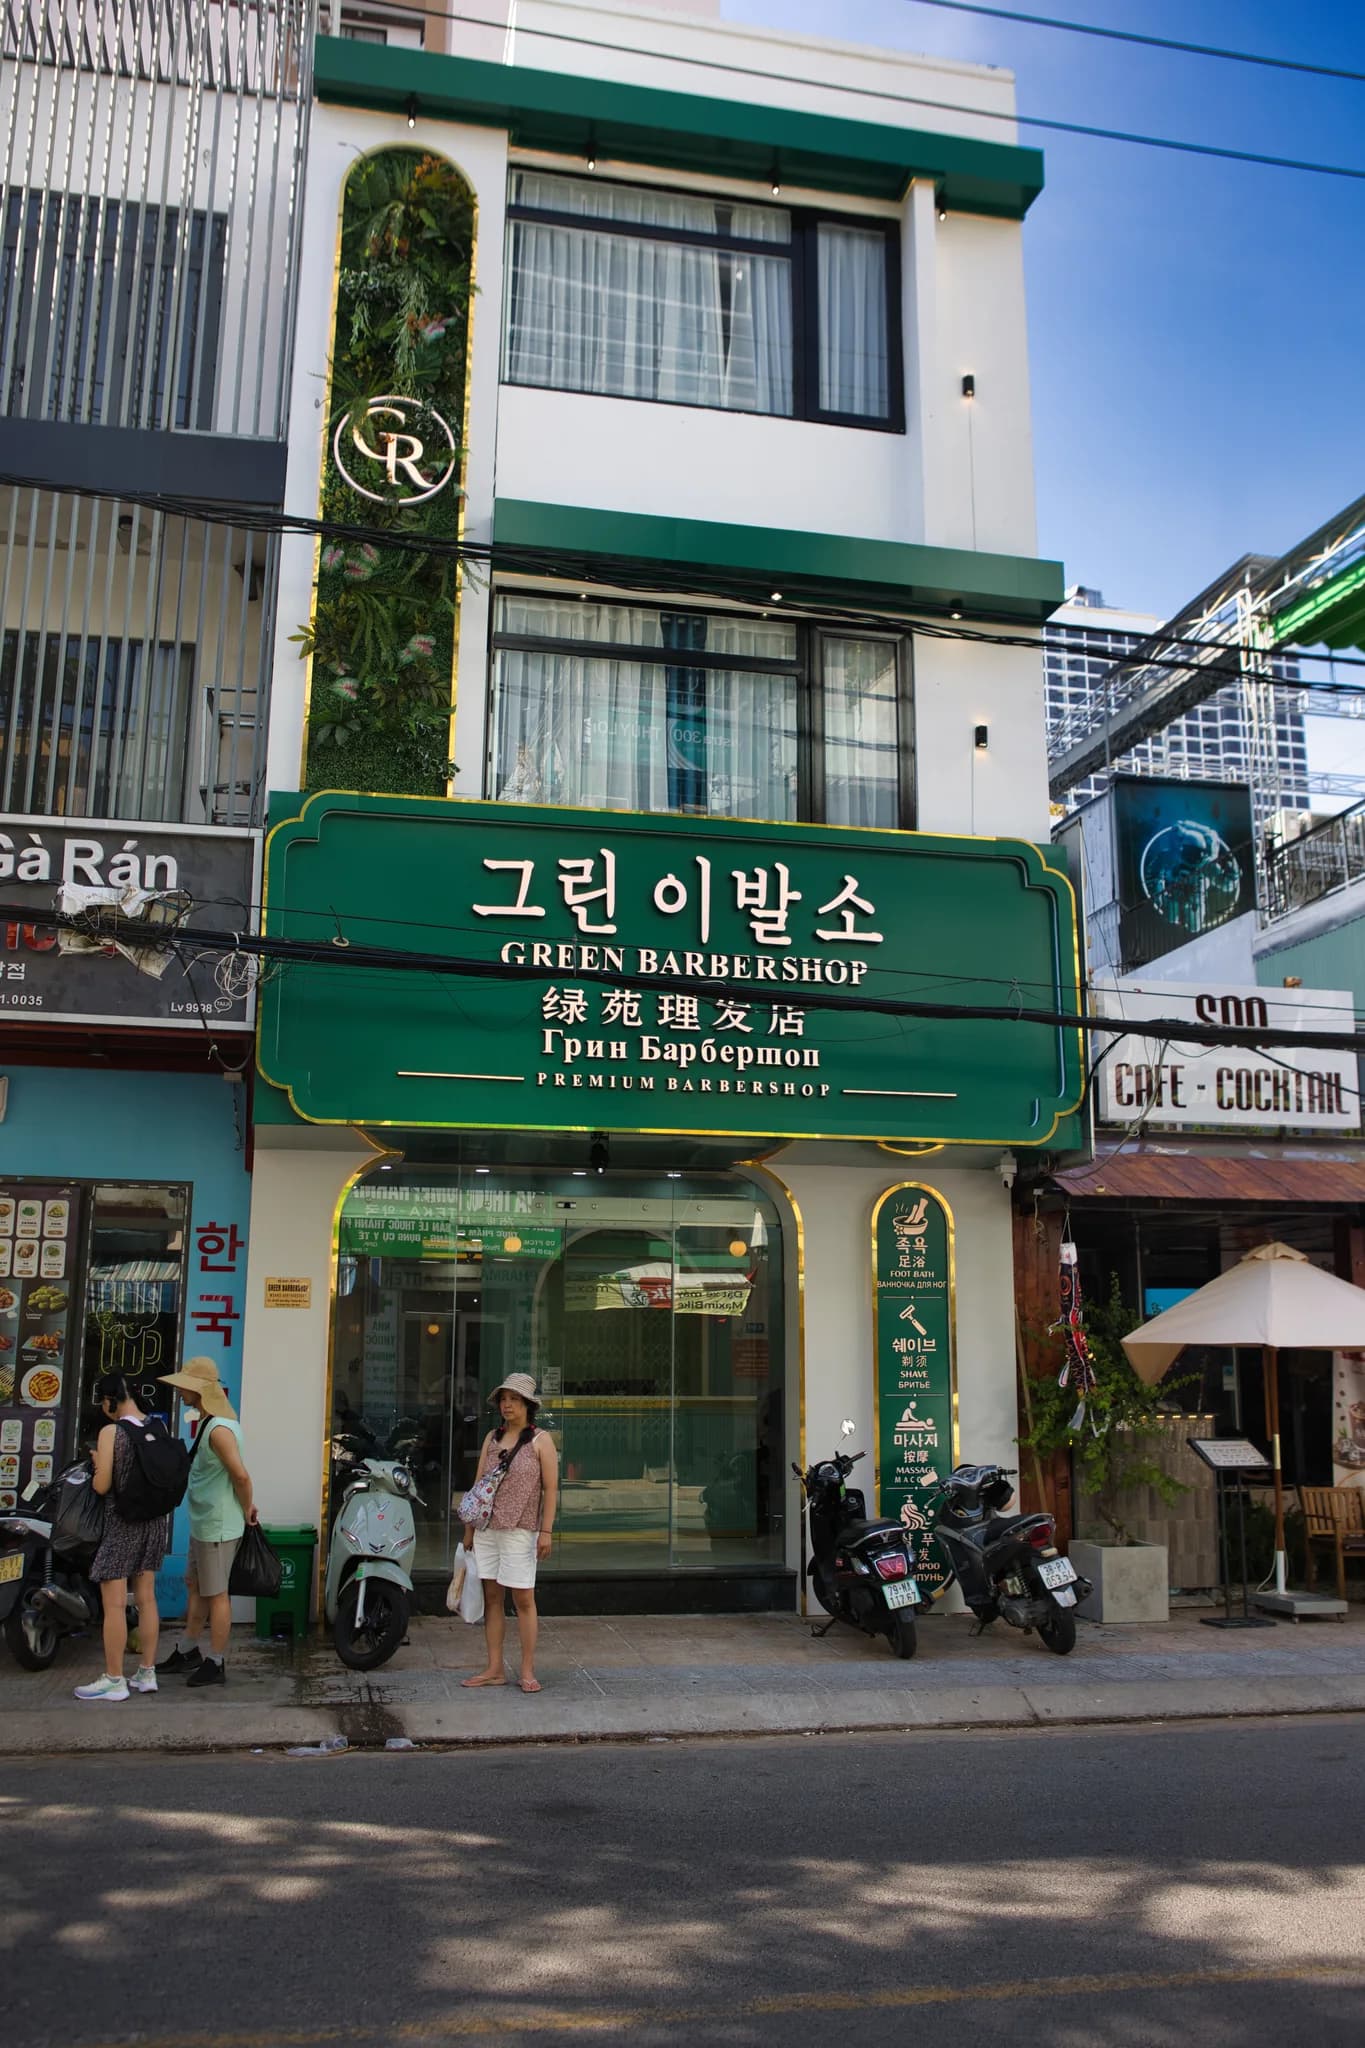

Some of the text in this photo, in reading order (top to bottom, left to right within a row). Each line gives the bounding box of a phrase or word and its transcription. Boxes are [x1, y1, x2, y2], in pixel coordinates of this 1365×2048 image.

[63, 839, 178, 890] Rán
[472, 848, 885, 946] 그린 이발소
[500, 941, 869, 986] GREEN BARBERSHOP
[542, 985, 806, 1037] 绿苑理发店
[541, 1028, 821, 1072] Грин Барбершоп
[536, 1071, 831, 1098] PREMIUM BARBERSHOP
[1115, 1062, 1188, 1109] CAFE
[1216, 1066, 1351, 1115] COCKTAIL
[896, 1237, 929, 1255] 족욕
[898, 1255, 926, 1268] 足浴
[890, 1270, 935, 1278] FOOT BATH
[891, 1338, 936, 1353] 쉐이브
[900, 1370, 929, 1378] SHAVE
[898, 1381, 931, 1390] БРИТЬЕ
[893, 1432, 938, 1448] 마사지
[904, 1450, 929, 1463] 按摩
[896, 1466, 936, 1475] MASSAGE
